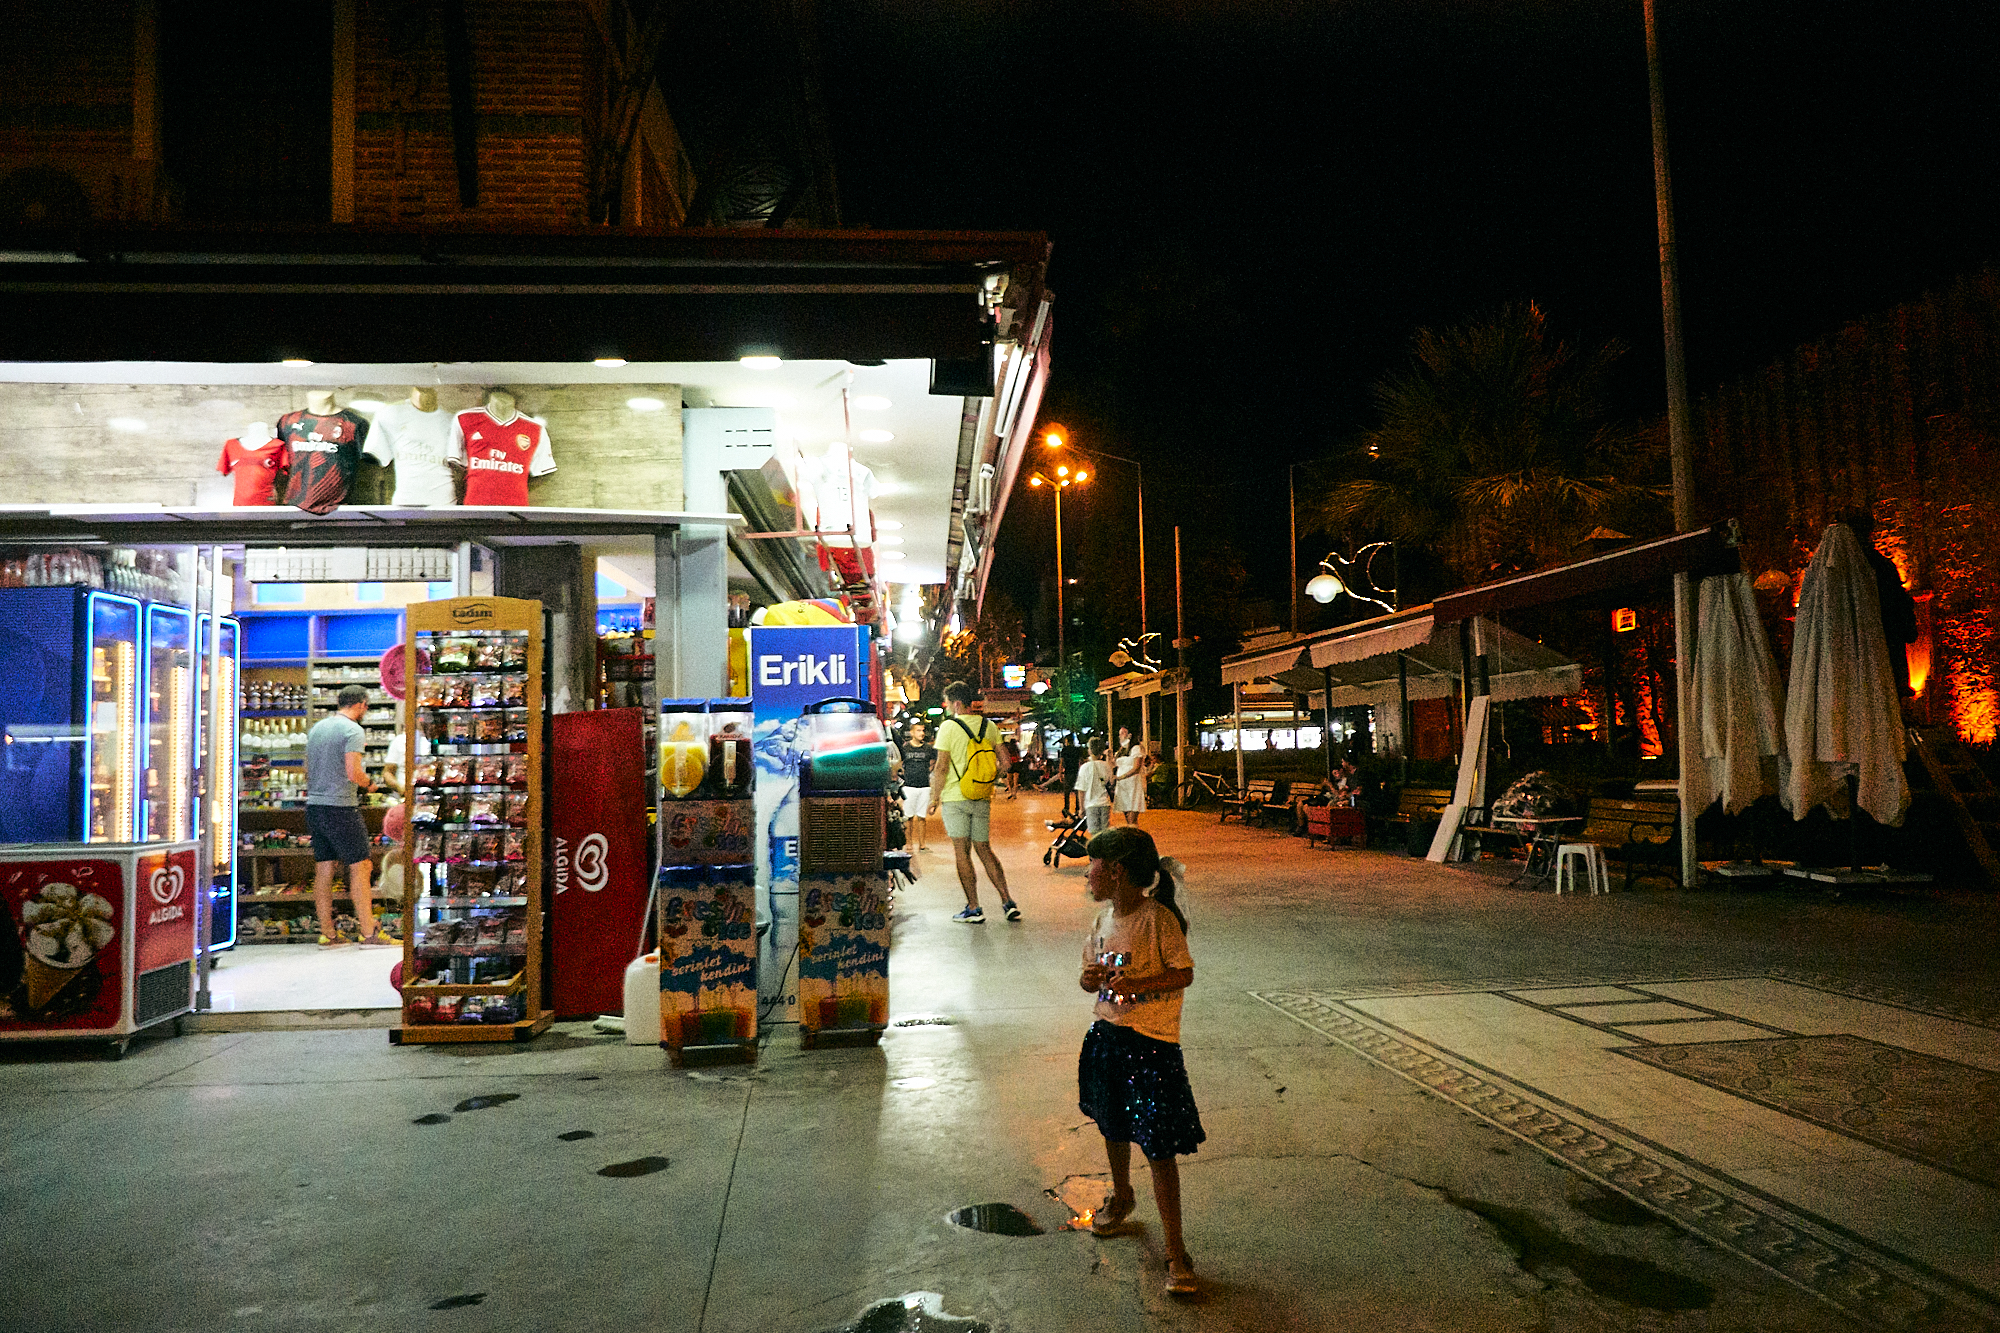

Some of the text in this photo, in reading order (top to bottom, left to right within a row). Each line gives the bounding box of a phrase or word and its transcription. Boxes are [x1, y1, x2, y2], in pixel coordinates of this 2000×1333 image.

[291, 440, 339, 453] Emirates
[490, 449, 507, 461] Fly
[470, 456, 524, 475] Emirates
[759, 653, 847, 686] Erikli
[556, 837, 569, 895] ALGIDA
[149, 906, 185, 925] ALGIDA
[700, 958, 752, 983] kendini
